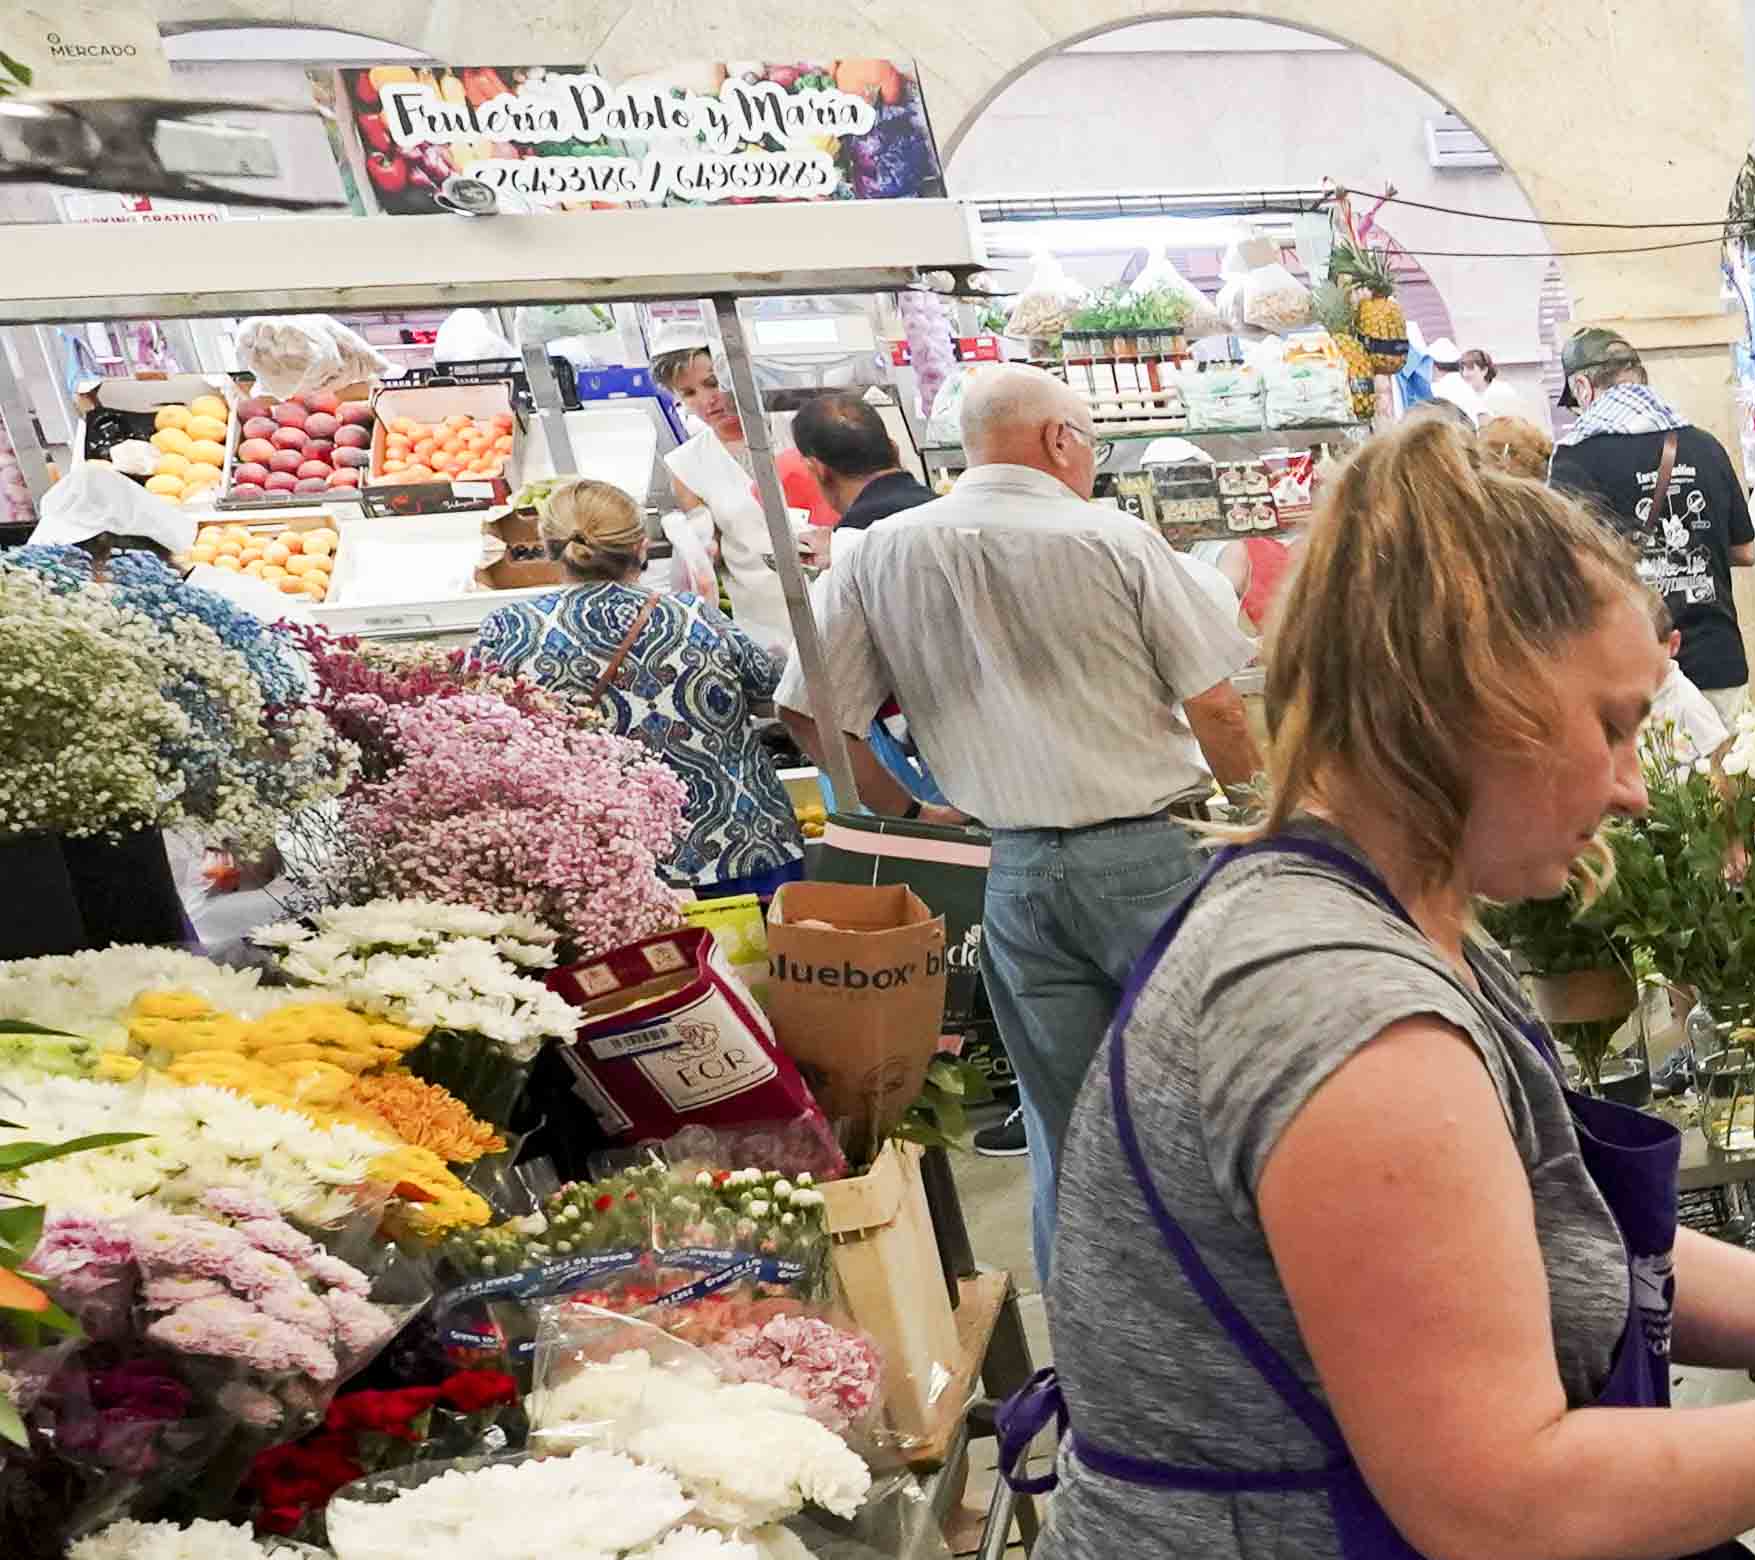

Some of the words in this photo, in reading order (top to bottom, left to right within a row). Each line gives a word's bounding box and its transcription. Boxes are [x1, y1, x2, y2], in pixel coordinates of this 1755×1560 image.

[50, 44, 137, 57] MERCADO
[392, 92, 558, 136] Frutería
[569, 84, 690, 130] Pablo
[706, 107, 731, 144] y
[734, 88, 858, 136] María
[677, 160, 827, 190] 649699885
